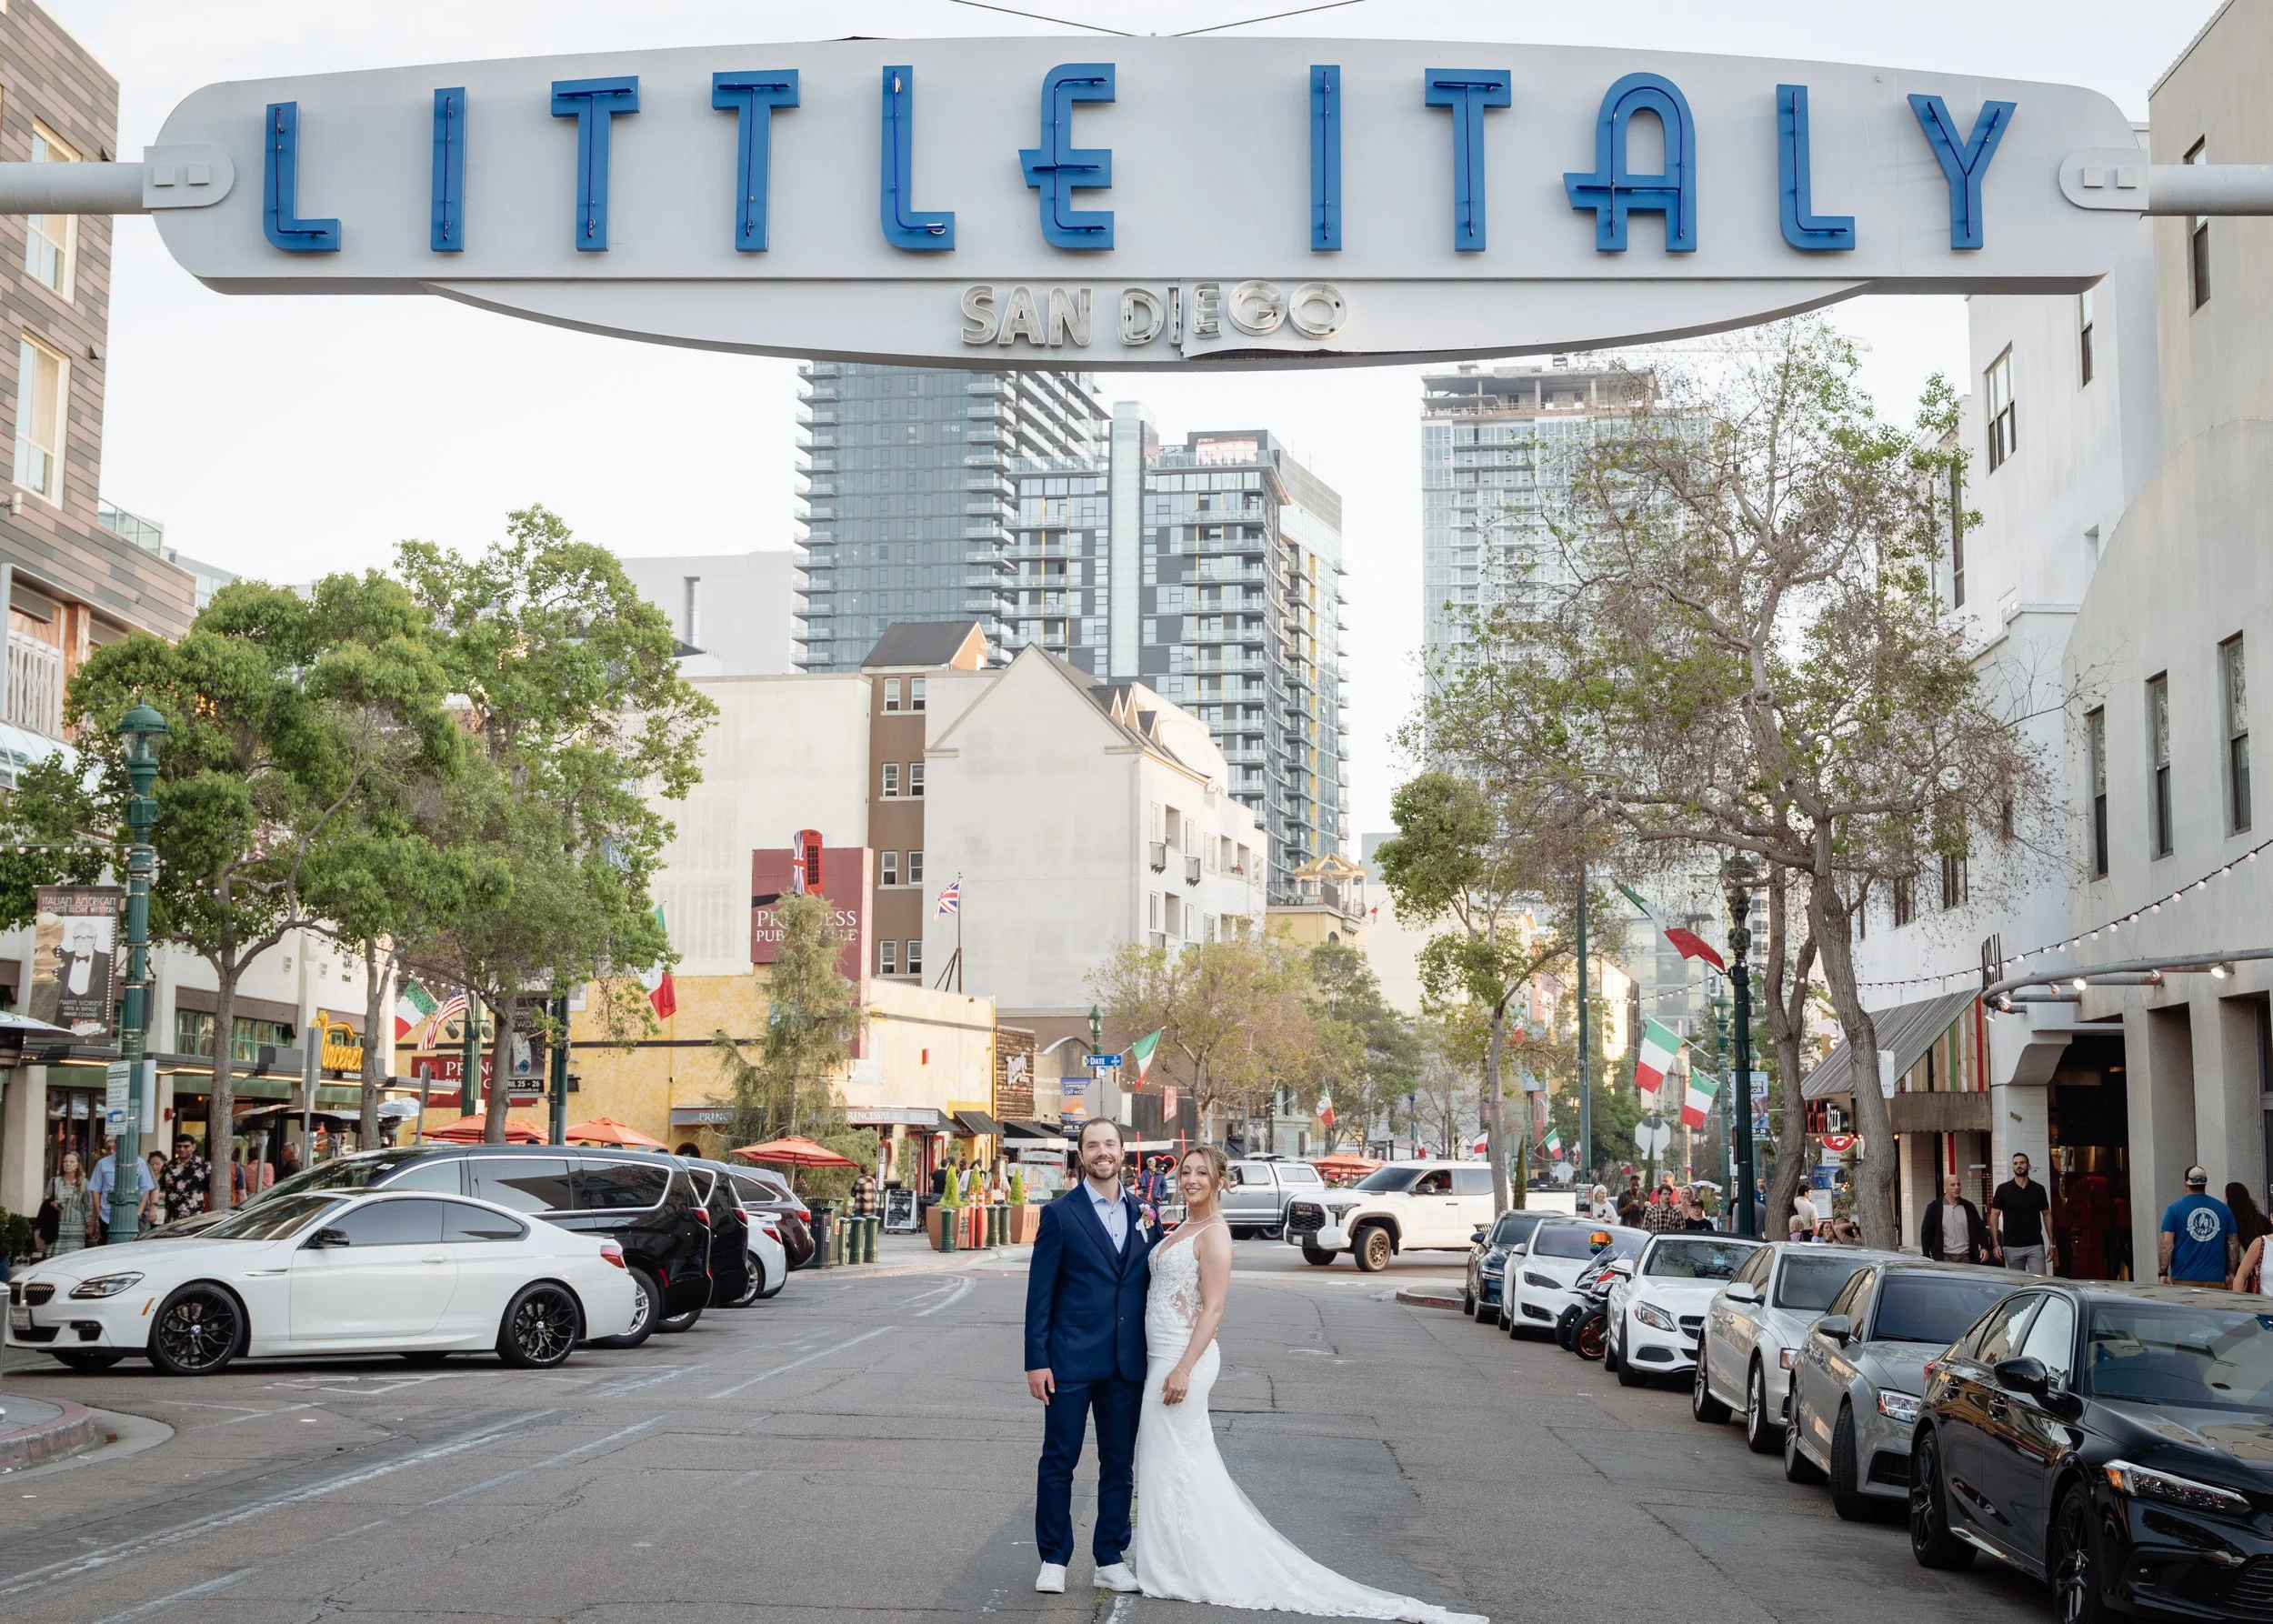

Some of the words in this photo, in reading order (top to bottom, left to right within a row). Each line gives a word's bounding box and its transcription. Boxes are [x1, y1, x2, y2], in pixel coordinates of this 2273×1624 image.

[264, 63, 1116, 253] LITTLE
[1309, 64, 2018, 253] ITALY
[960, 284, 1092, 348] SAN
[1116, 279, 1348, 347] DIEGO
[42, 896, 72, 906] ITALIAN
[75, 896, 116, 906] AMERICAN
[1090, 1057, 1106, 1065] DATE
